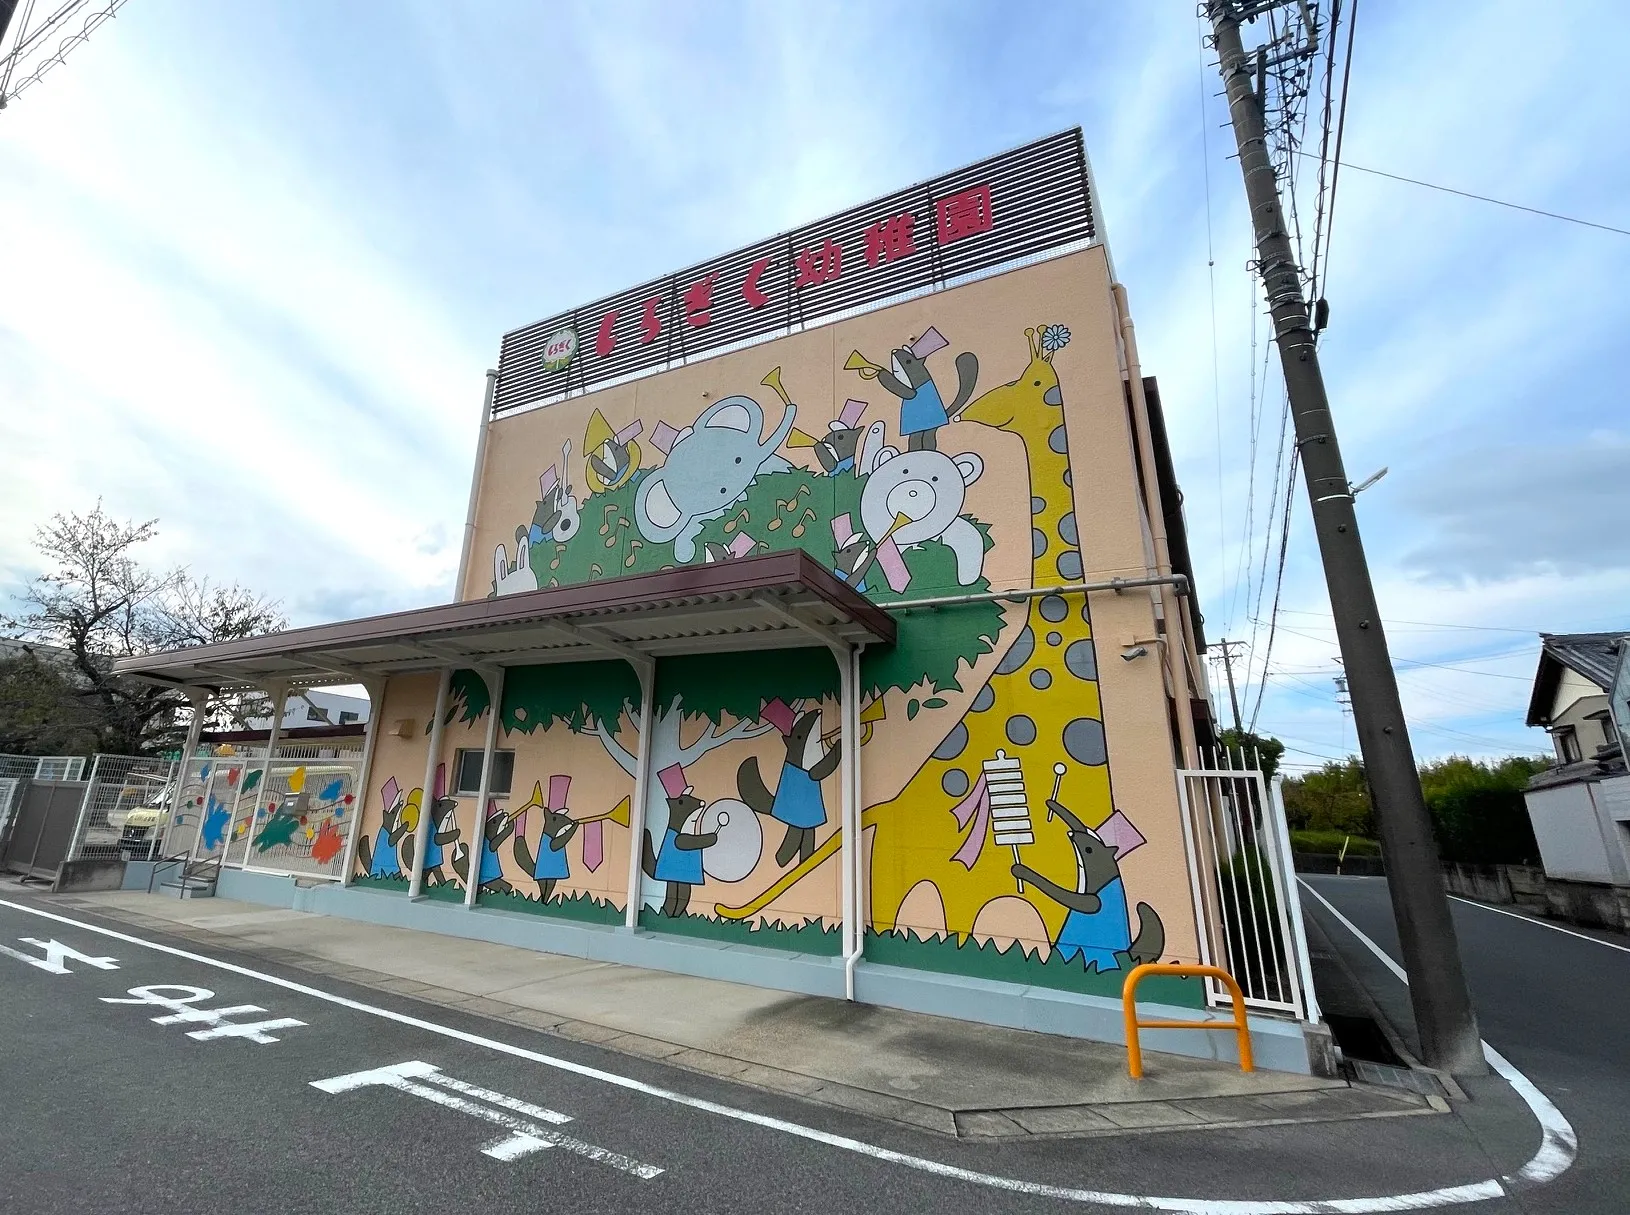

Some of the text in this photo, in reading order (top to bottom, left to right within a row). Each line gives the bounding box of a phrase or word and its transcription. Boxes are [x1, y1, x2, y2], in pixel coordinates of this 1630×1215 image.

[595, 184, 994, 357] しろぎく幼稚園
